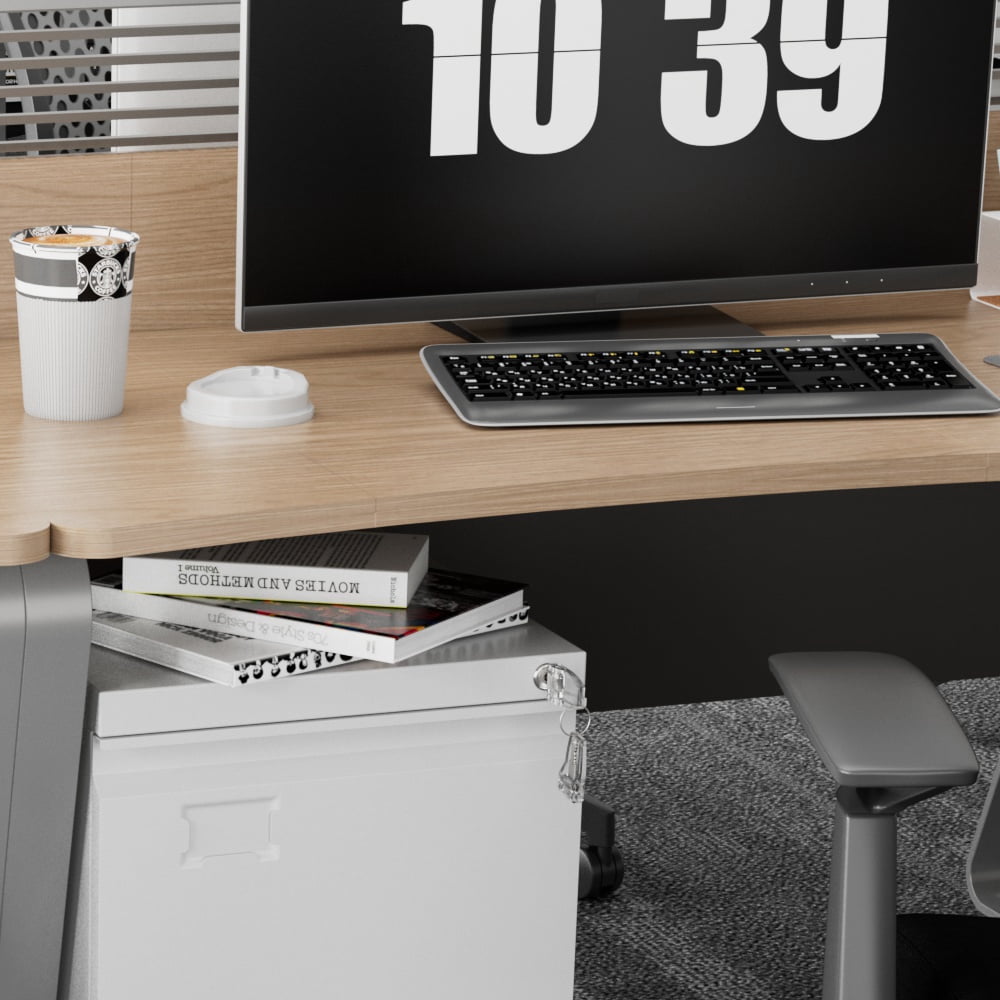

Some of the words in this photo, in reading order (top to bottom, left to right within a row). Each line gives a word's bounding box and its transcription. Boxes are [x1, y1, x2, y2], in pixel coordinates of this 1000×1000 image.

[402, 0, 602, 156] 10
[661, 0, 889, 146] 39
[178, 564, 183, 572] I
[185, 564, 220, 574] Volume
[178, 573, 255, 588] METHODS
[257, 577, 291, 590] AND
[295, 580, 360, 594] MOVIES
[208, 613, 255, 633] Design
[259, 623, 270, 635] &
[272, 625, 305, 642] Style
